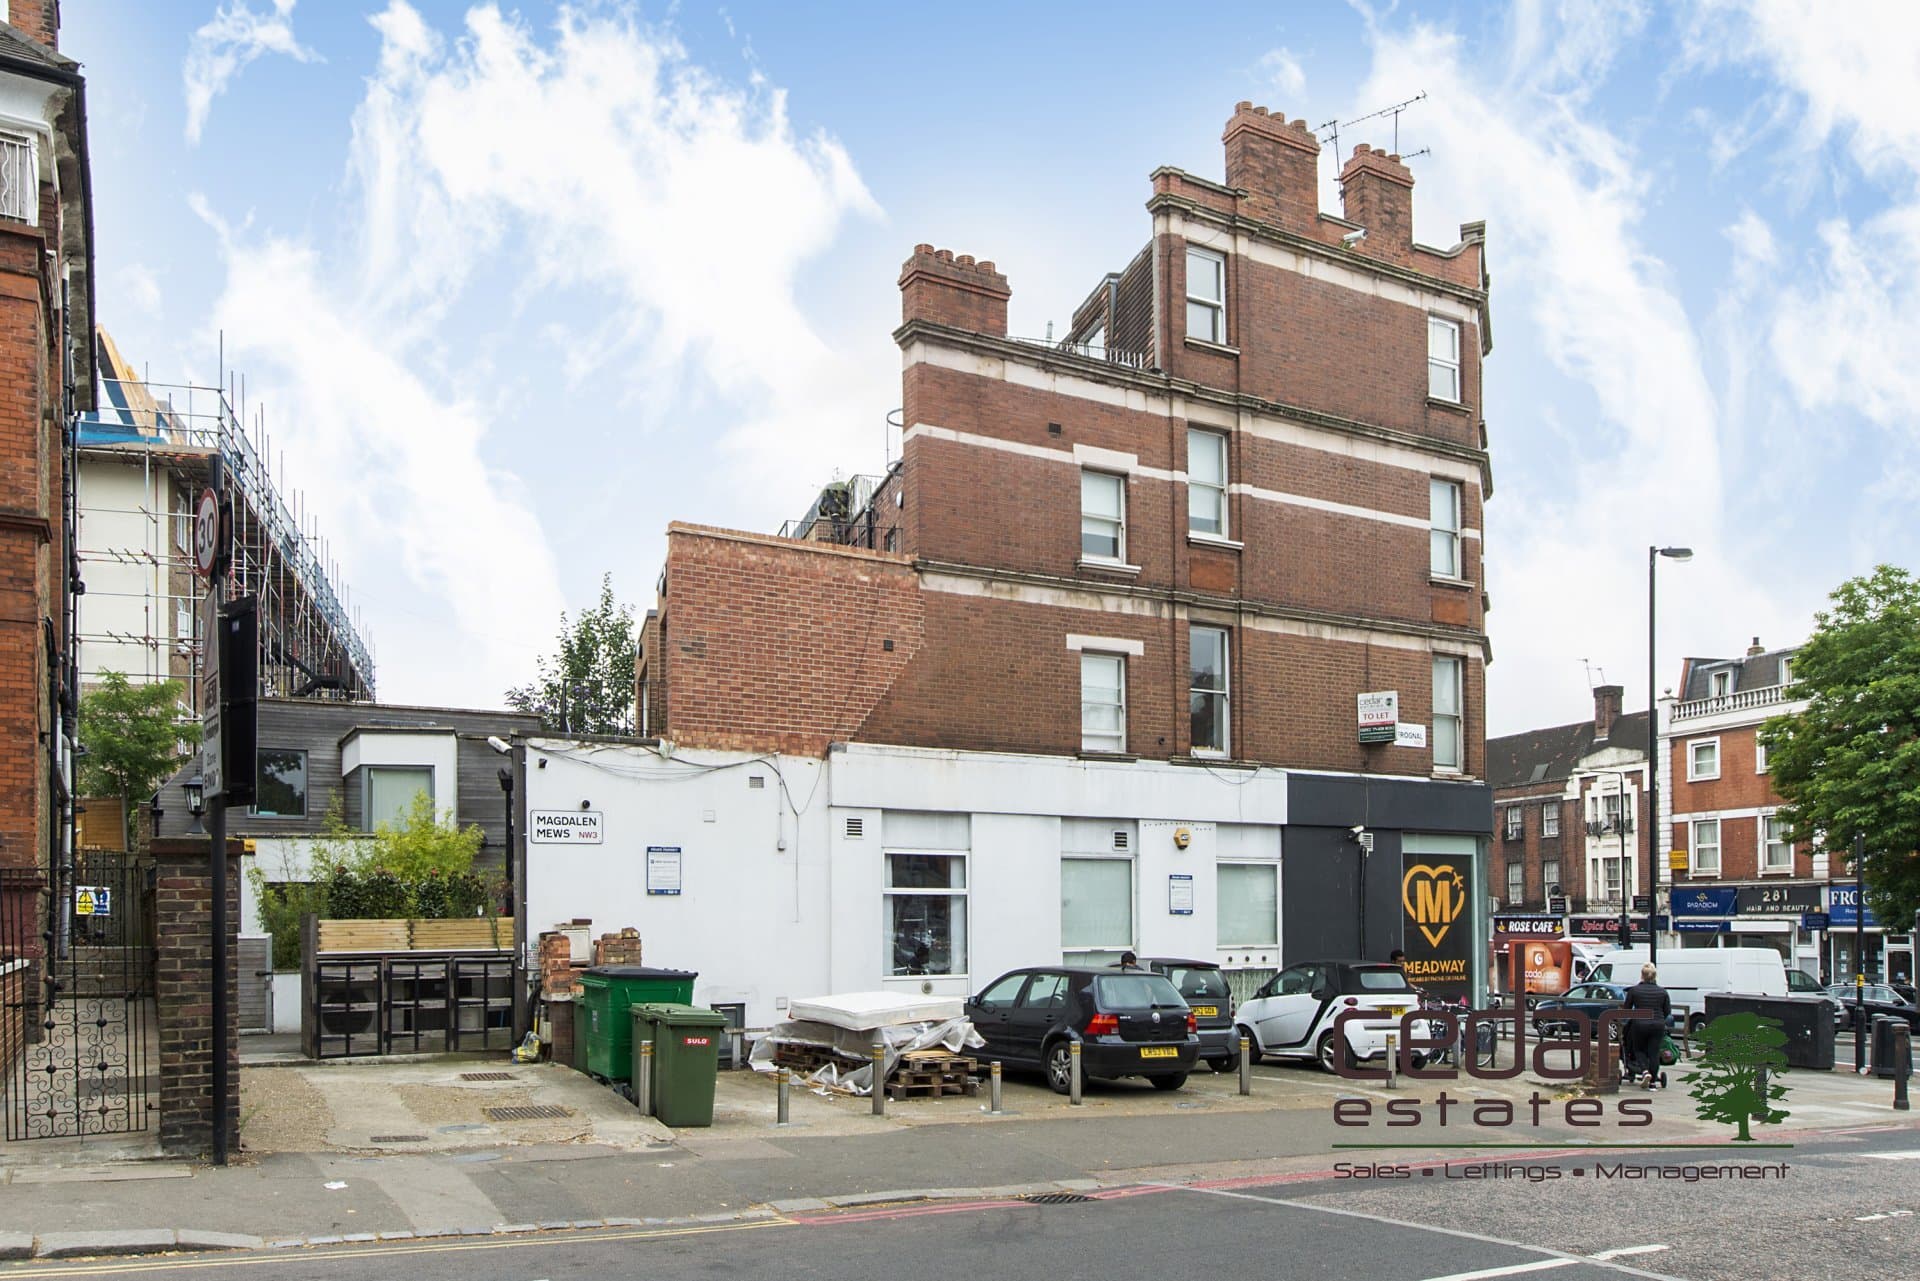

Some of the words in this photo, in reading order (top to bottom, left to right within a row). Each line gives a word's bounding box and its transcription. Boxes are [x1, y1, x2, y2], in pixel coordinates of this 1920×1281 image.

[199, 511, 215, 554] 30
[1376, 711, 1389, 720] LET
[536, 815, 597, 827] MAGDALEN
[536, 828, 571, 838] MEWS
[578, 831, 598, 839] NW3
[1762, 889, 1789, 902] 281
[1782, 904, 1810, 912] BEAUTY
[1508, 921, 1531, 933] ROSE
[1532, 920, 1554, 933] CAFE
[1581, 920, 1604, 933] Spice
[1605, 920, 1638, 931] Gaen
[1404, 959, 1466, 974] MEADWAY
